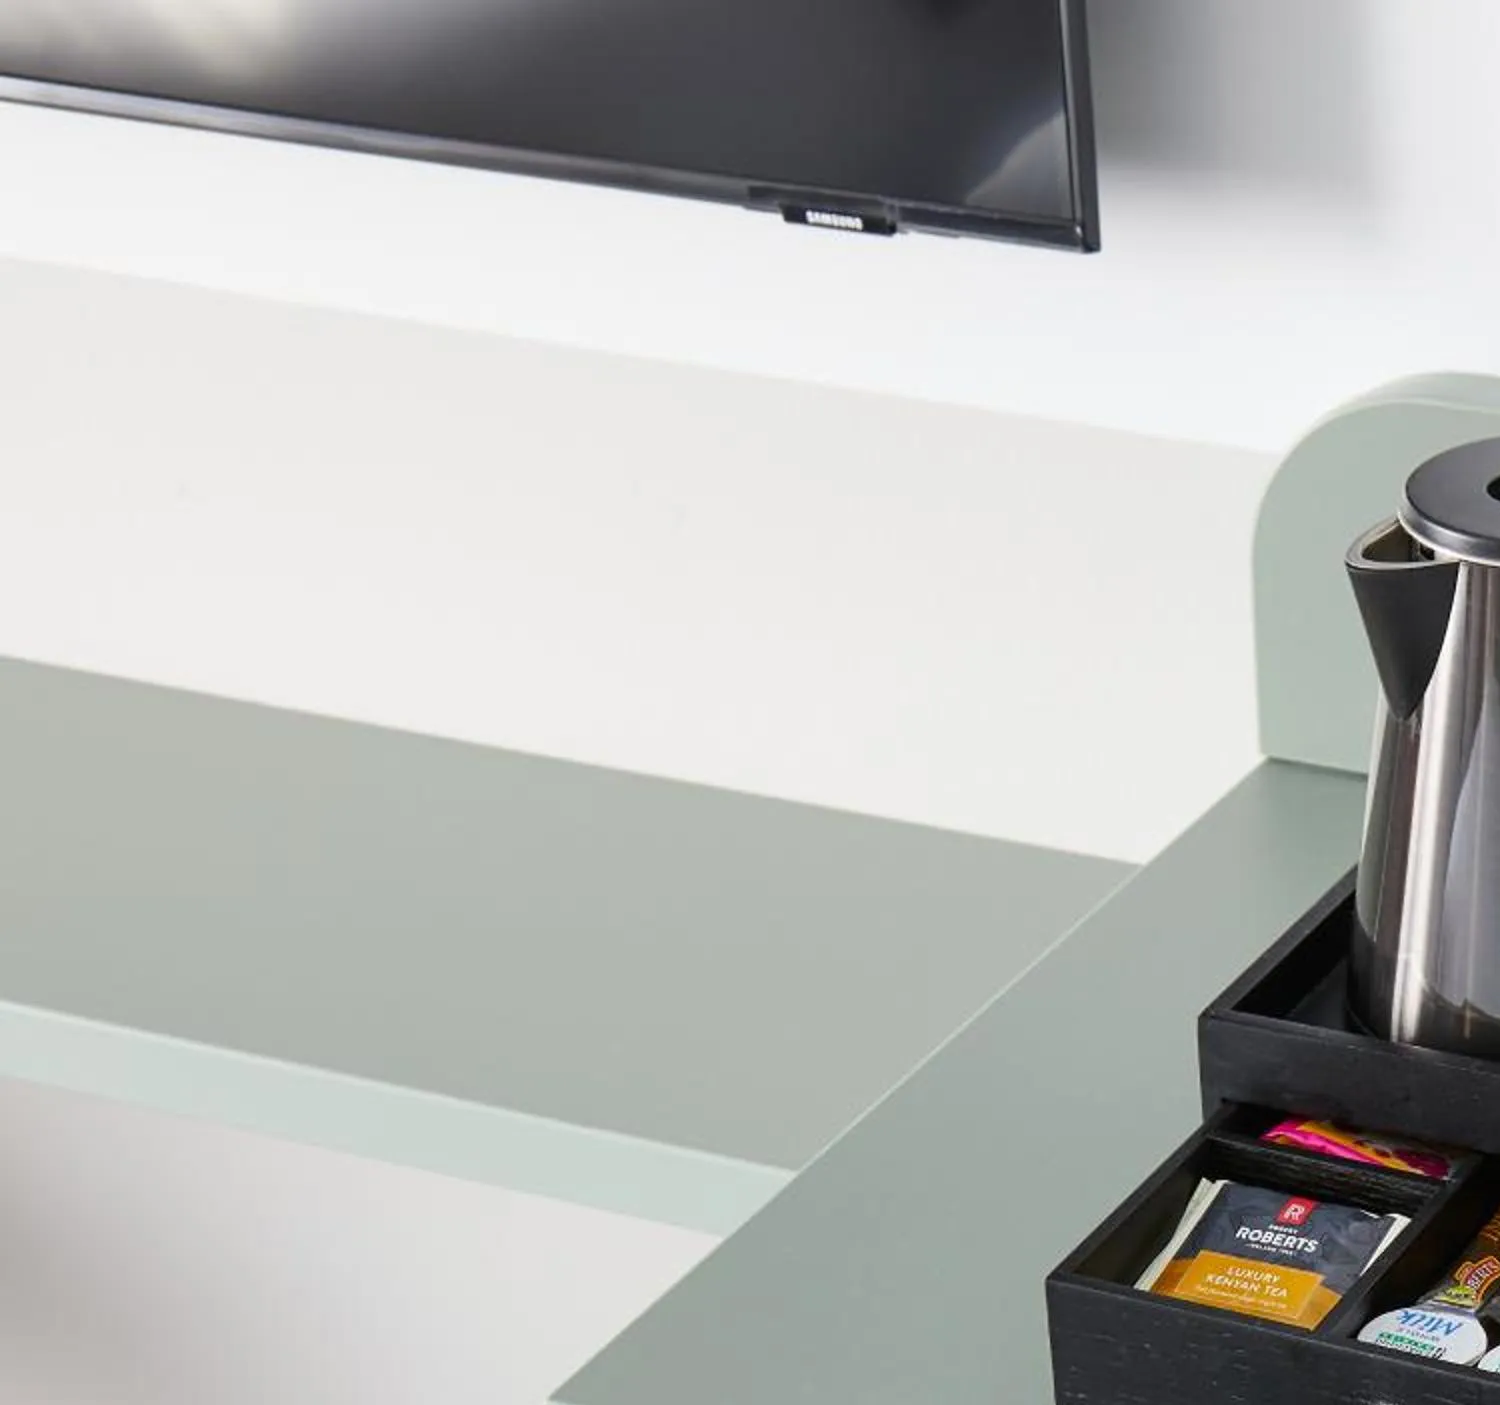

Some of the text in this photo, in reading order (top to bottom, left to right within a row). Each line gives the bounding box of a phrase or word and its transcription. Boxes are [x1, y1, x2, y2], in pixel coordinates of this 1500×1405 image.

[1235, 1226, 1319, 1253] ROBERTS
[1205, 1273, 1261, 1293] KENYAN
[1263, 1284, 1288, 1298] TEA
[1226, 1267, 1280, 1284] LUXURY
[1397, 1309, 1463, 1336] Milk
